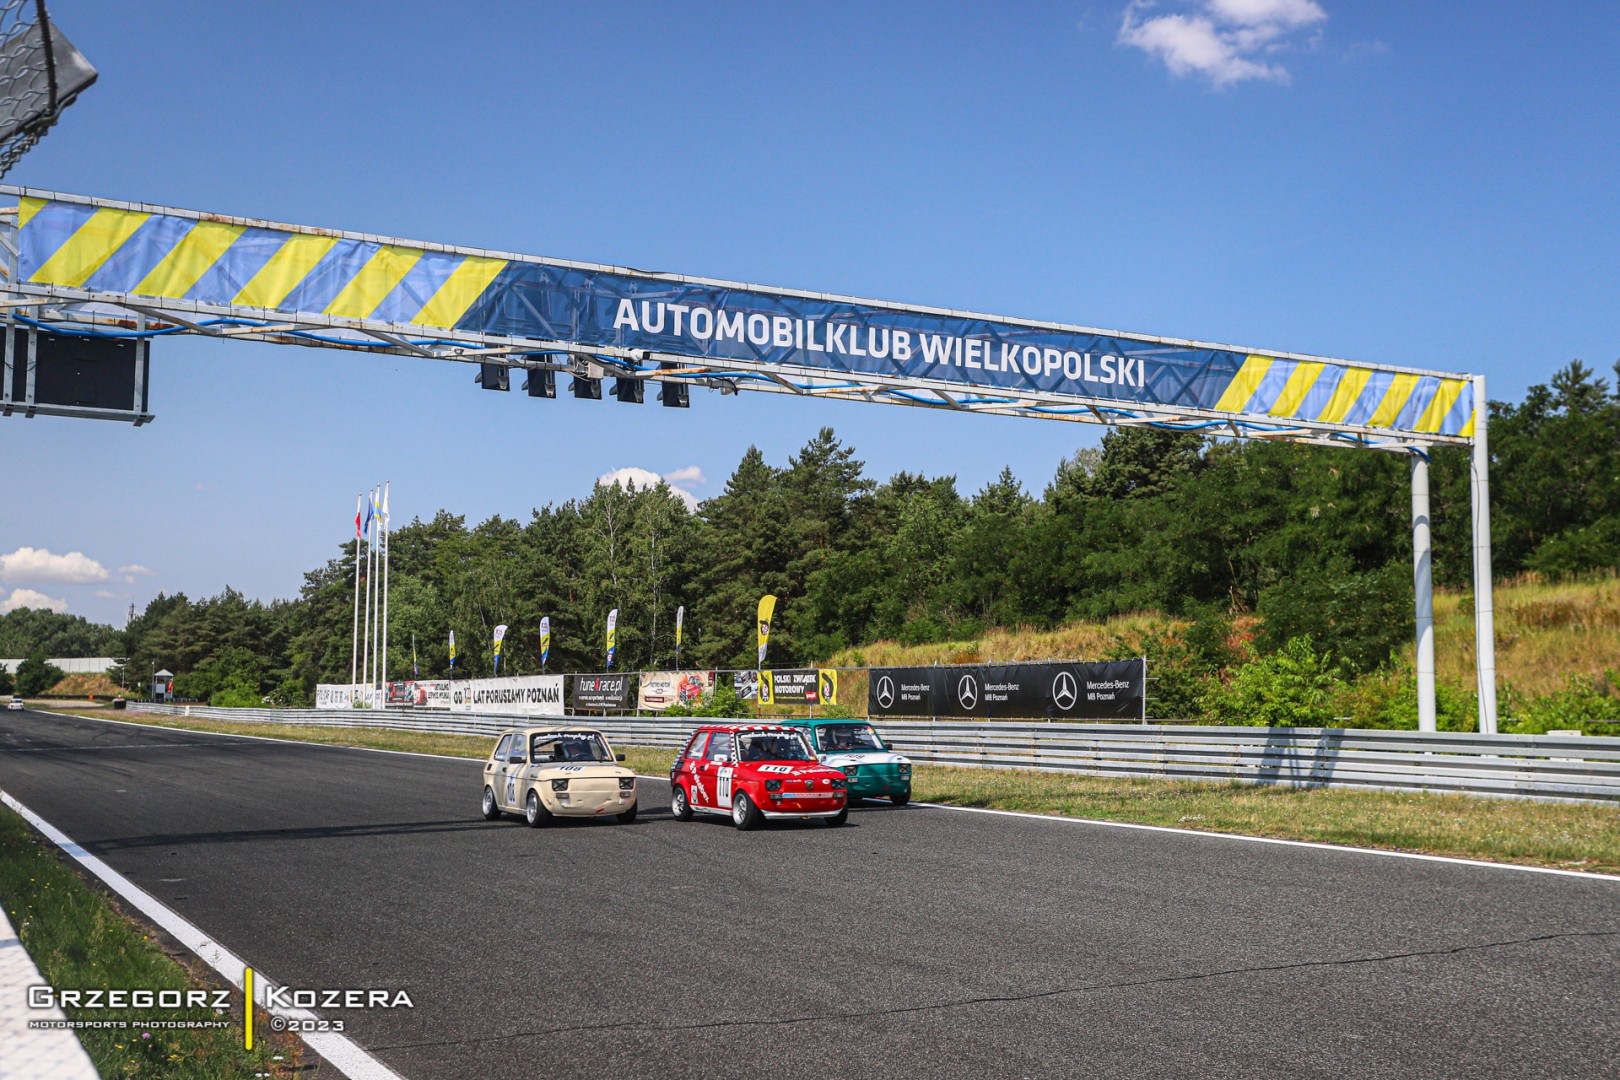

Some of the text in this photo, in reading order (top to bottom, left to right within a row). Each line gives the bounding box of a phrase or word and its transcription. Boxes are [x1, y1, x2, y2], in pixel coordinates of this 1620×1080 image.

[613, 298, 1145, 387] AUTOMOBILKLUB WIELKOPOLSKI
[774, 674, 817, 685] POLSKI ZWIĄZEK
[774, 685, 805, 694] MOTOROWY
[901, 683, 930, 691] Mercedes-Benz
[984, 683, 1019, 691] Mercedes-Benz
[1086, 680, 1129, 690] Mercedes-Benz
[454, 691, 463, 704] OD
[473, 690, 485, 704] LAT
[486, 688, 525, 704] PORUSZAMY
[527, 683, 560, 703] POZNAŃ
[993, 693, 1008, 701] Poznań
[1097, 691, 1115, 700] Poznań
[719, 776, 730, 798] 110
